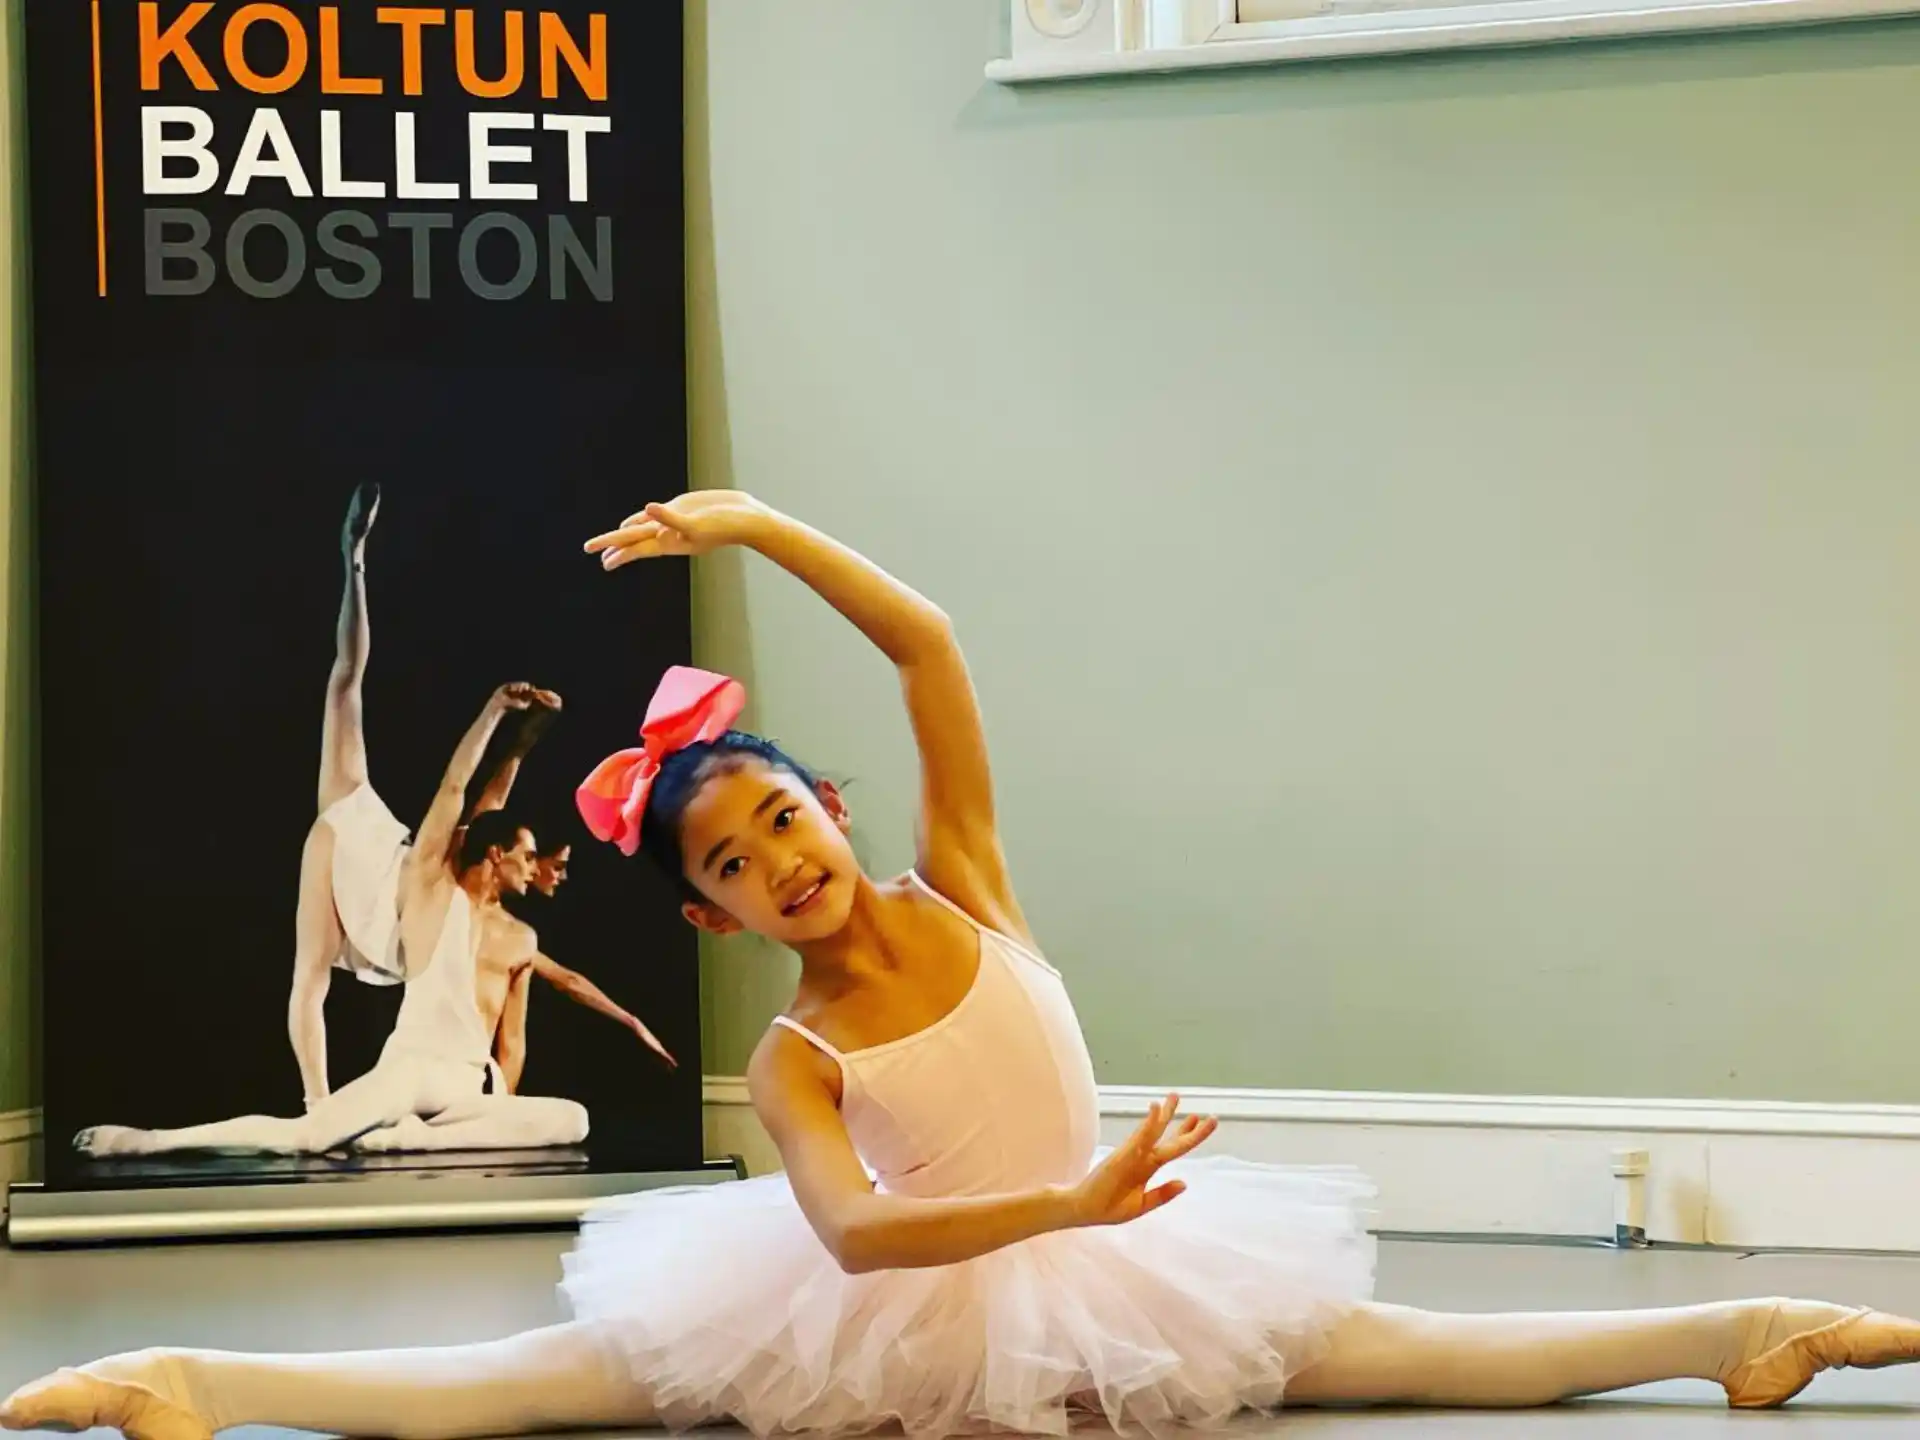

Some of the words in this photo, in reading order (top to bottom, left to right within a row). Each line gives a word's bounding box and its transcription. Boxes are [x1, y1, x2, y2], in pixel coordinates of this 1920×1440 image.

[138, 2, 608, 101] KOLTUN
[141, 105, 611, 202] BALLET
[144, 208, 613, 302] BOSTON
